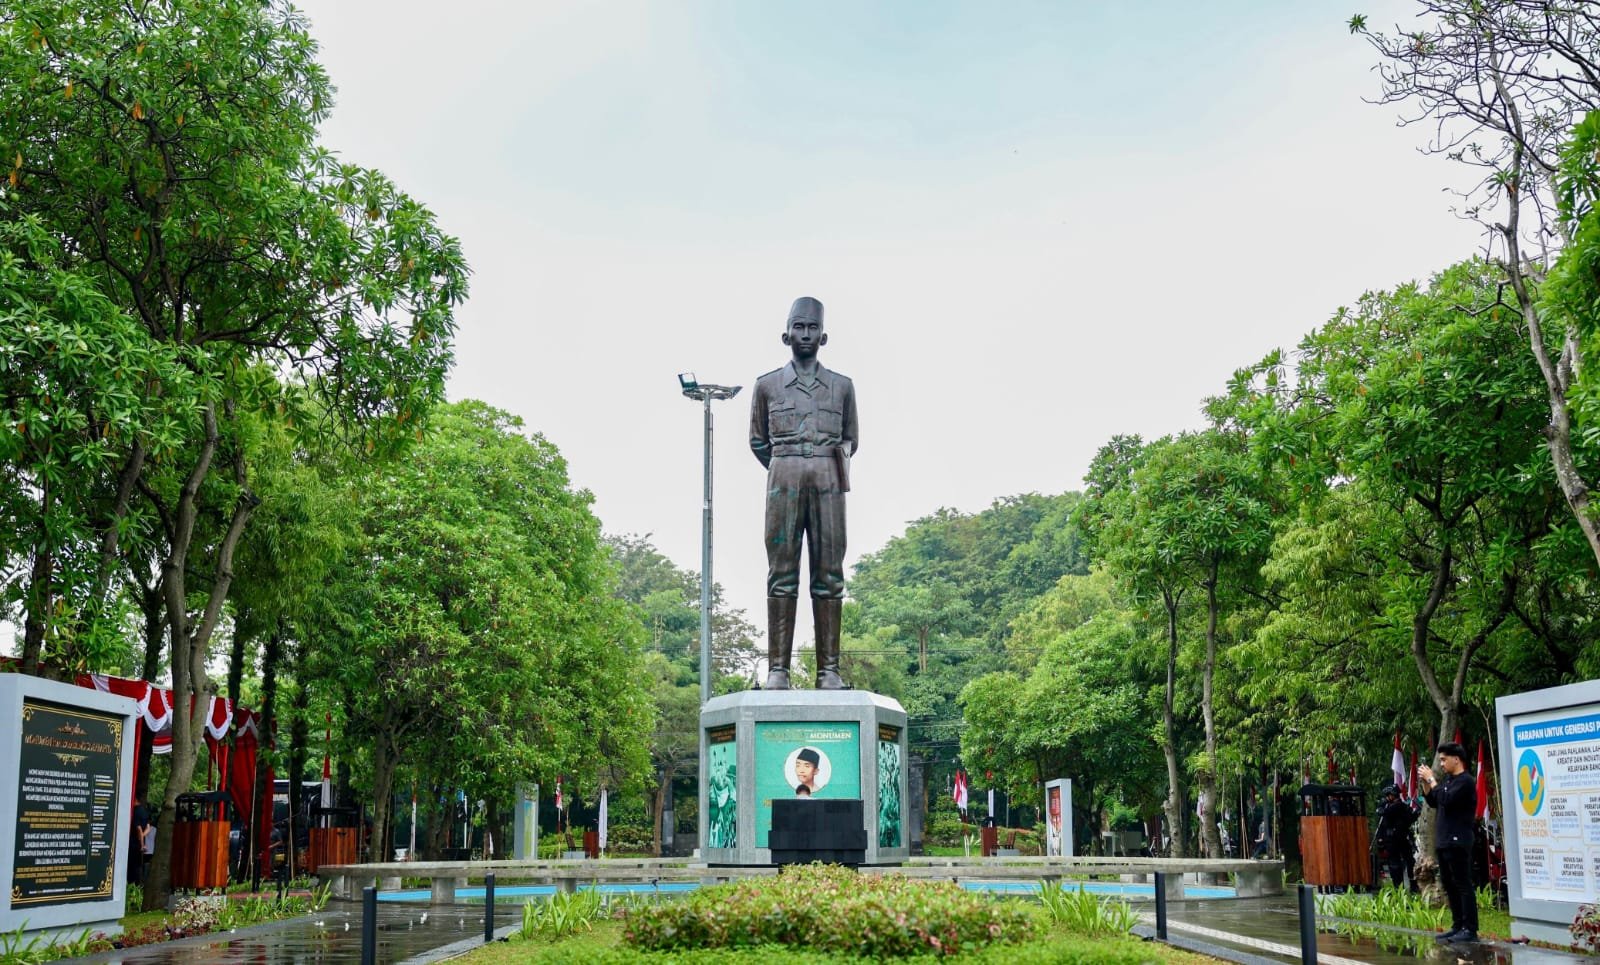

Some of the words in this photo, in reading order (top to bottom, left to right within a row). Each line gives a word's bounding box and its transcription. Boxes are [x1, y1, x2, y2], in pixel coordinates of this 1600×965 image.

[1518, 729, 1544, 742] HARAPAN
[1544, 725, 1564, 738] UNTUK
[1566, 721, 1596, 735] GENERASI
